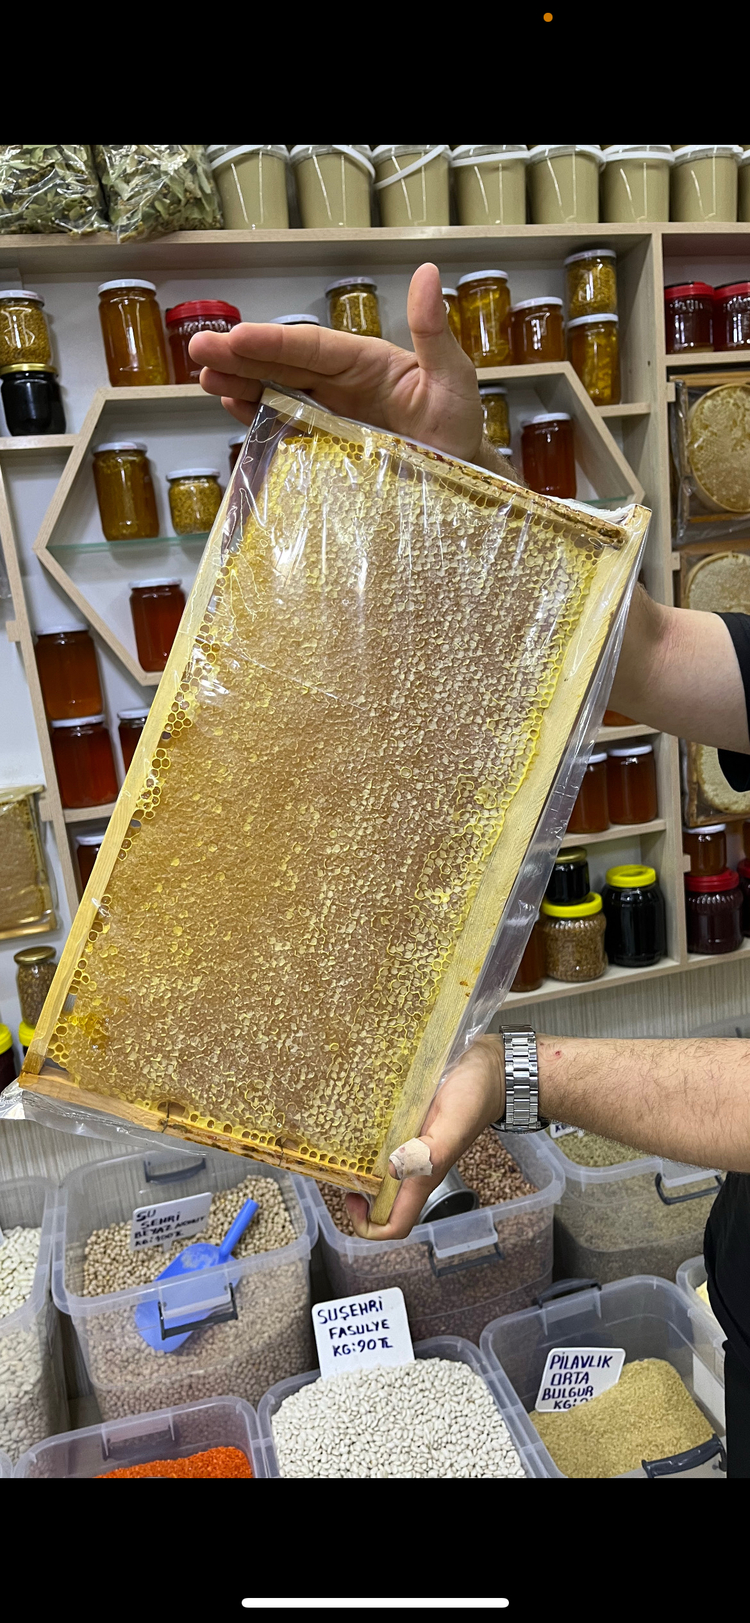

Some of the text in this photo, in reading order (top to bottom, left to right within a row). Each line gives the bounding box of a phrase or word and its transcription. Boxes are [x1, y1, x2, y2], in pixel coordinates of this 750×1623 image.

[136, 1209, 156, 1222] SU
[317, 1295, 383, 1325] SUŞEHRİ
[328, 1319, 390, 1340] FASULYE
[549, 1351, 614, 1370] PİLAVLIK
[550, 1371, 590, 1386] ORTA
[541, 1385, 594, 1401] BULGUR
